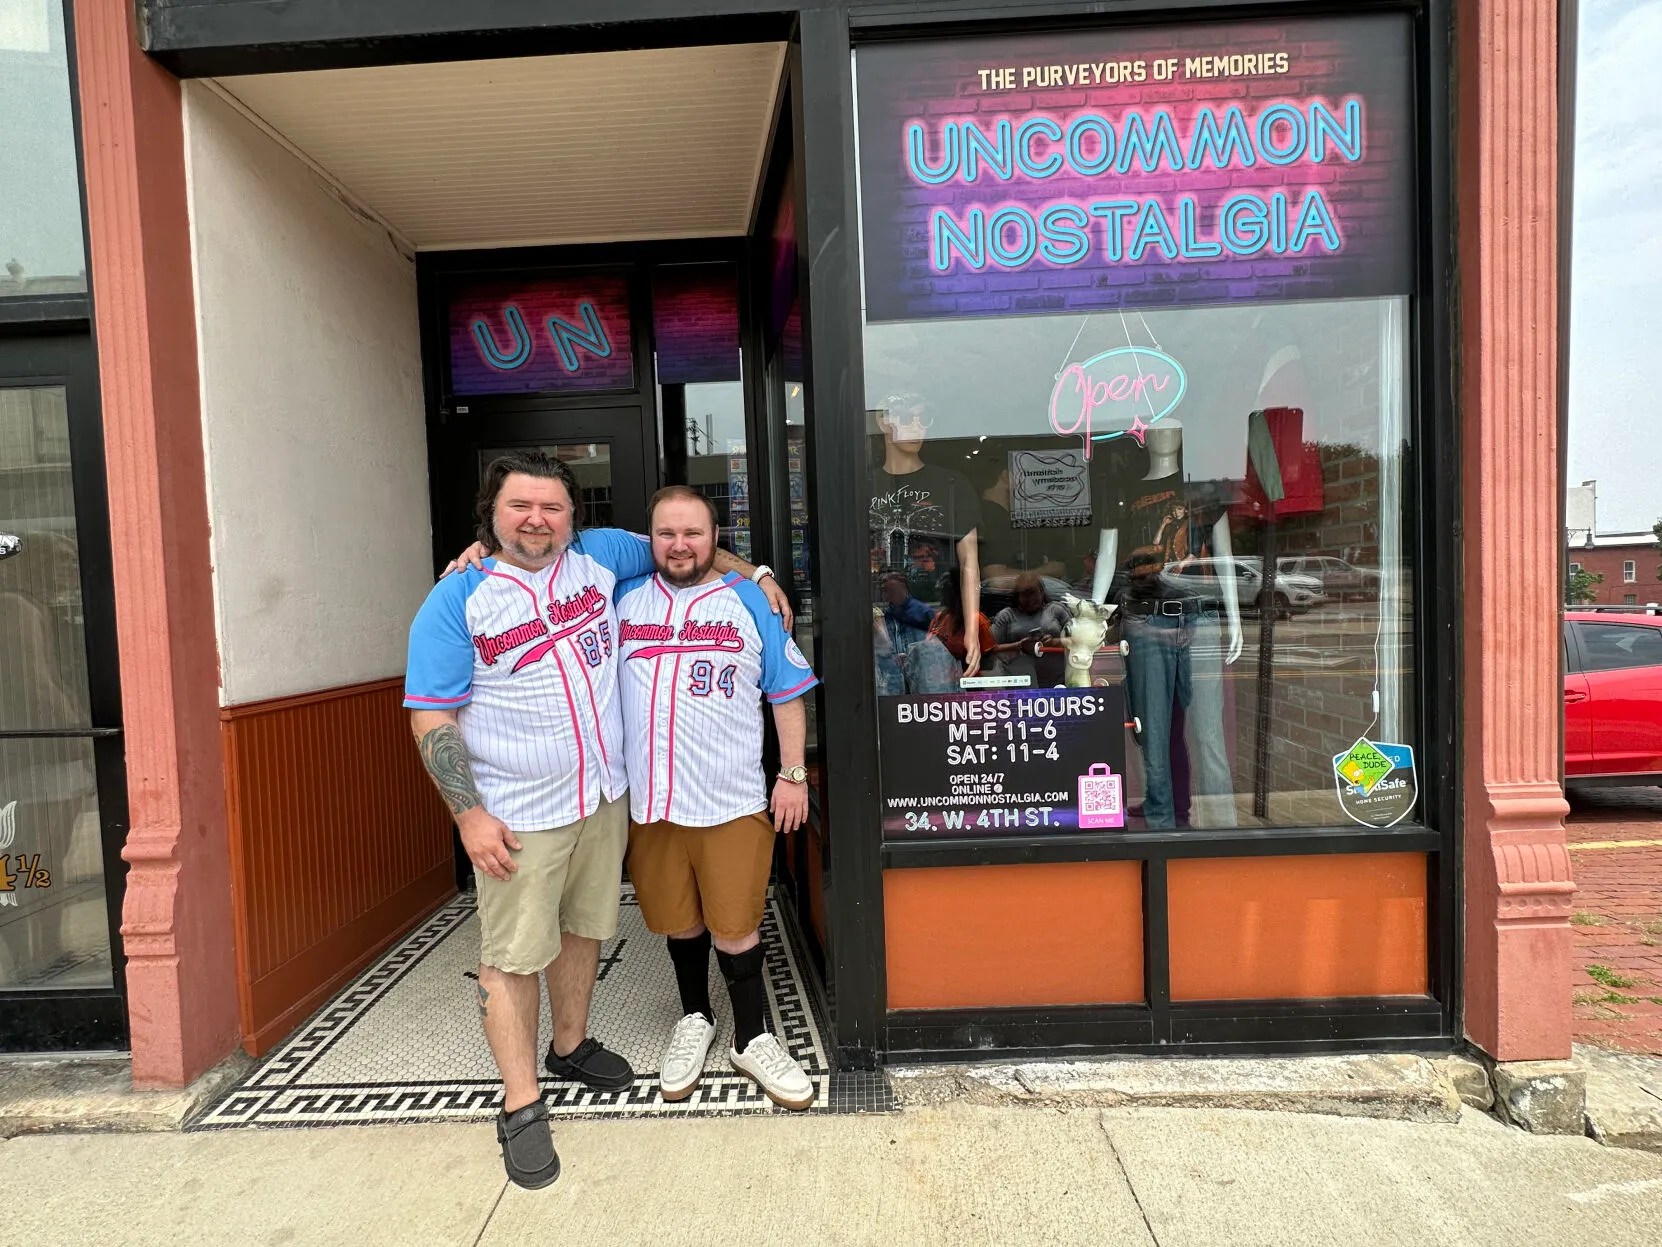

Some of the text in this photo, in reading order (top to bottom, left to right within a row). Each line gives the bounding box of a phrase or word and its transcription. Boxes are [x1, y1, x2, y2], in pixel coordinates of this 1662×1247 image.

[977, 52, 1289, 90] THE PURVEYORS OF MEMORIES
[908, 100, 1361, 184] UNCOMMON
[934, 190, 1340, 270] NOSTALGIA
[473, 303, 611, 371] UN
[1051, 365, 1170, 459] Open
[870, 484, 931, 510] PINK FLOYD
[473, 585, 606, 666] Uncommon Nostalgia
[619, 620, 740, 648] Uncommon Nostalgia
[576, 620, 612, 669] 85
[689, 660, 736, 700] 94
[897, 695, 1105, 723] BUSINESS HOURS:
[948, 719, 1057, 743] M-F 11-6
[946, 741, 1060, 765] SAT: 11-4
[1349, 752, 1381, 761] PEACE,
[1362, 760, 1386, 769] DUDE
[949, 772, 1005, 785] OPEN 24/7
[951, 784, 991, 795] ONLINE
[887, 791, 1069, 808] WWW.UNCOMMONNOSTALGIA.COM
[1373, 794, 1402, 802] SECURITY
[904, 806, 1060, 832] 34. W. 4TH ST.
